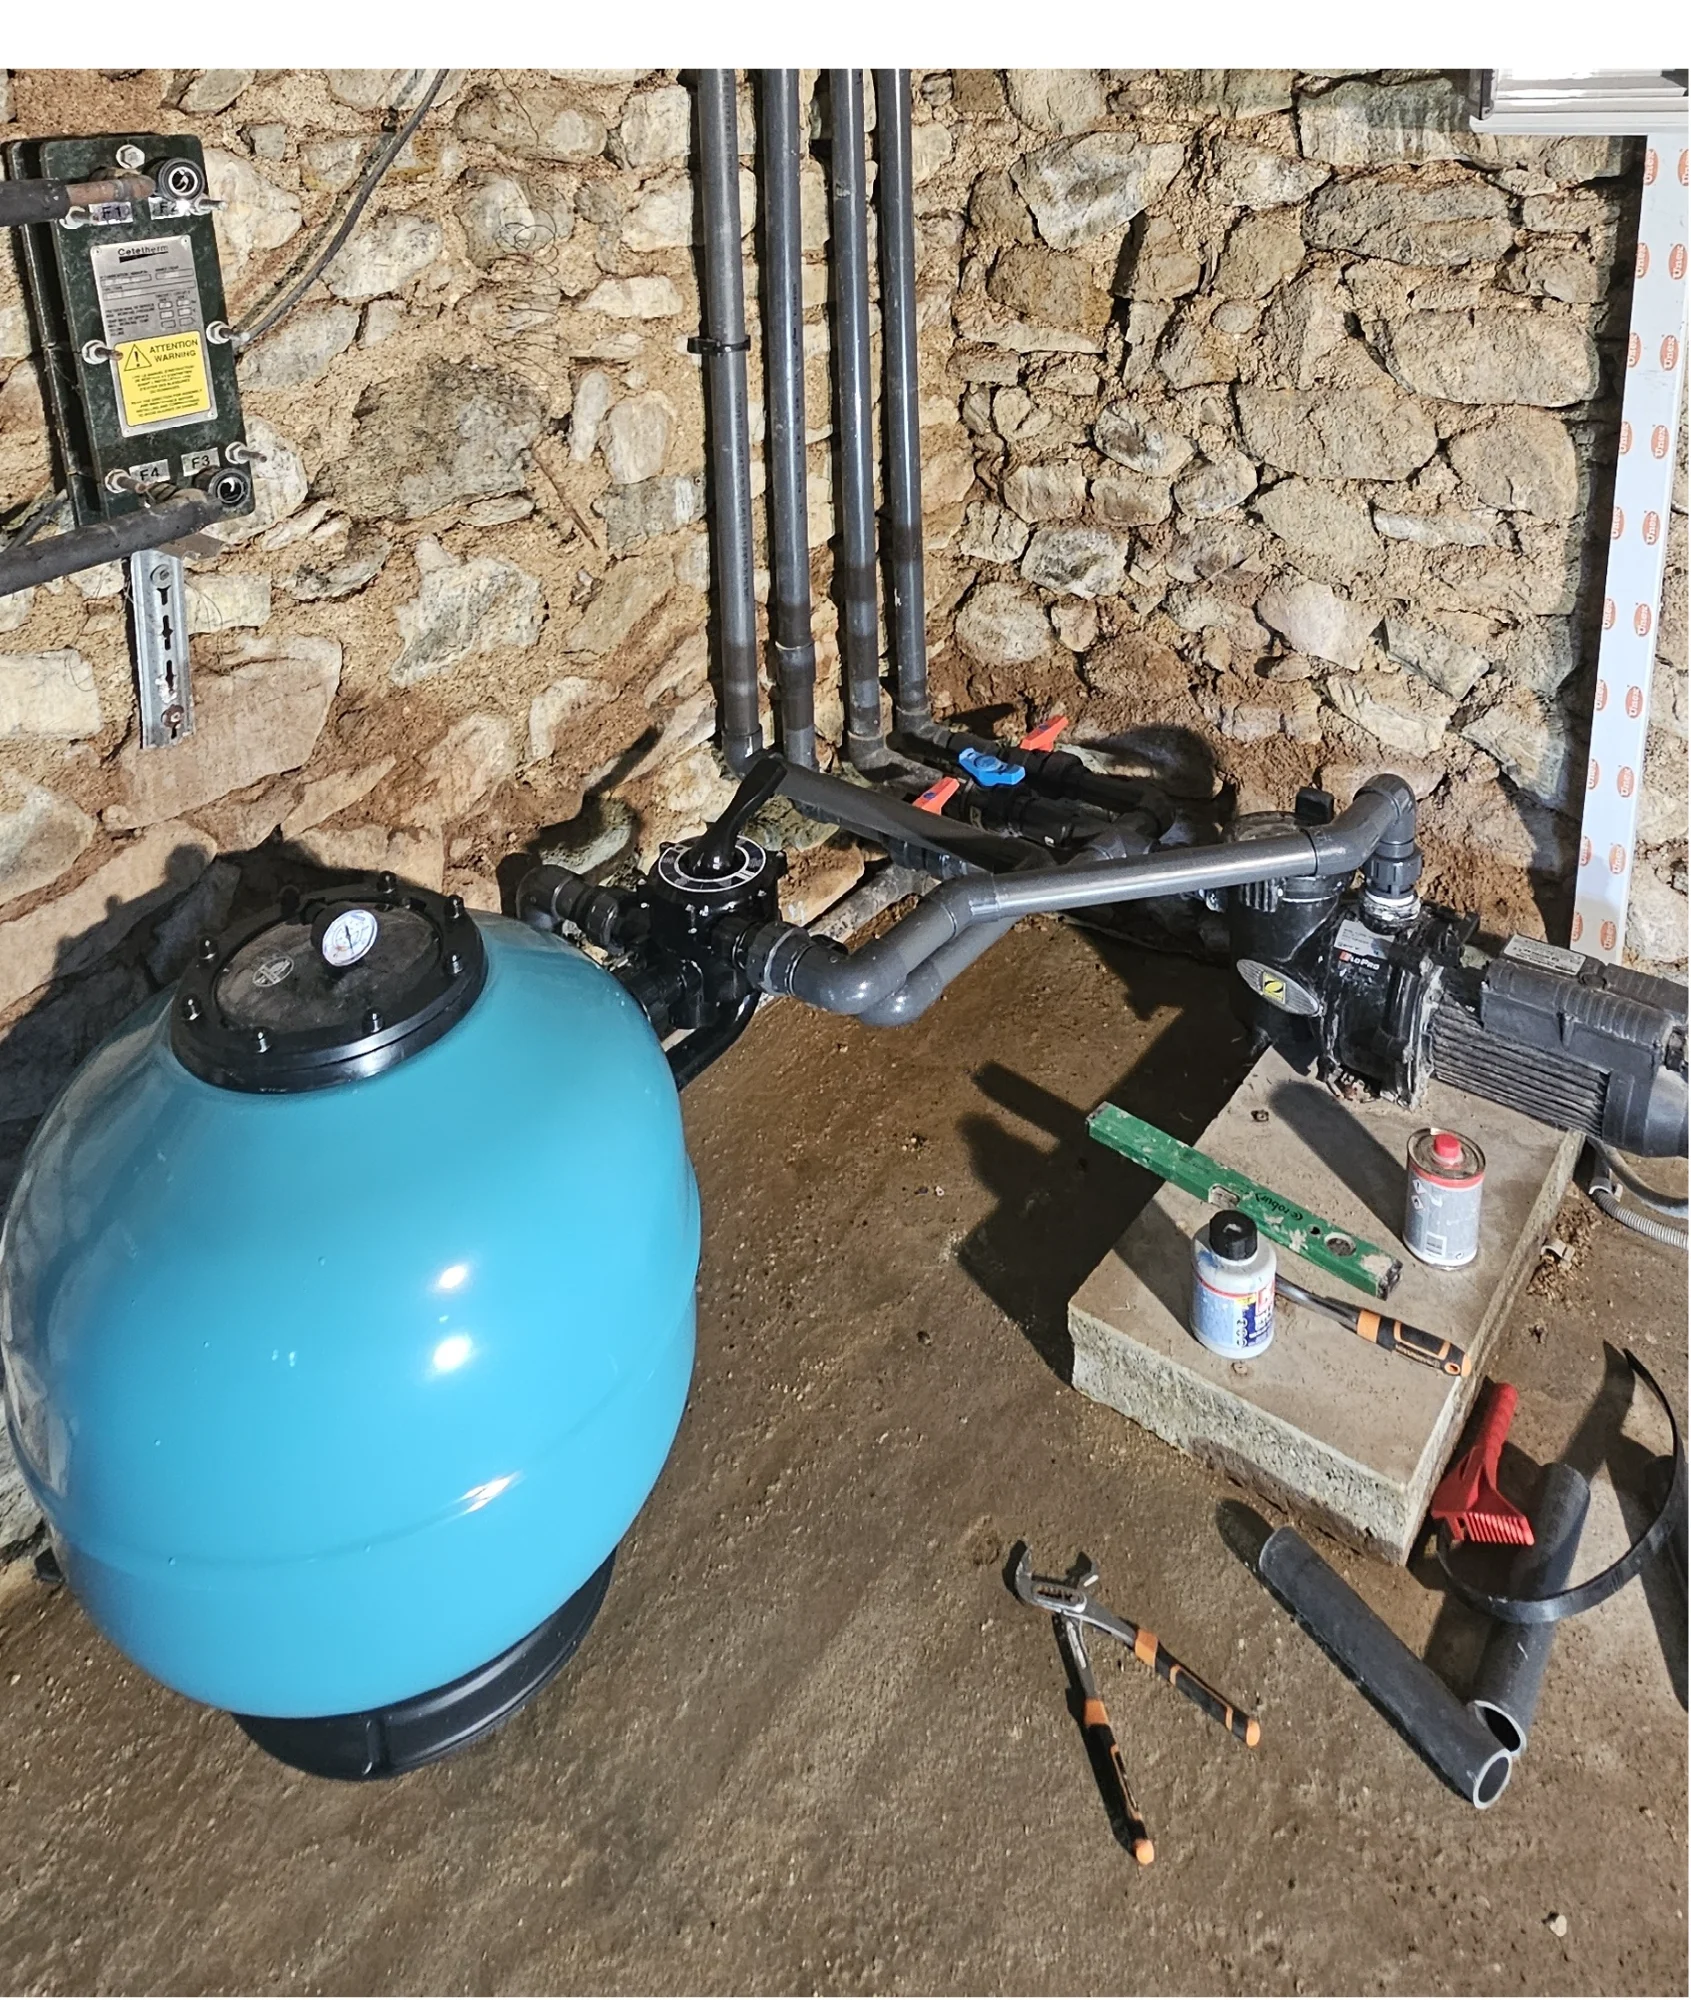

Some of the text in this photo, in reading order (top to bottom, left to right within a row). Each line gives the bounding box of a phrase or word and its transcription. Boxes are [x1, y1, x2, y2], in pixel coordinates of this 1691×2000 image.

[1643, 150, 1655, 183] Unex
[102, 206, 121, 219] F1
[117, 245, 169, 256] Cetetherm
[1672, 245, 1684, 279] Unex
[149, 339, 199, 354] ATTENTION
[154, 349, 197, 363] WARNING
[1627, 334, 1638, 366] Unex
[1663, 336, 1675, 369] Unex
[1619, 422, 1629, 453] Unex
[1654, 426, 1666, 457] Unex
[140, 467, 160, 481] F4
[191, 455, 210, 469] F3
[1611, 507, 1621, 538] Unex
[1646, 513, 1658, 543] Unex
[1603, 600, 1613, 629] Unex
[1637, 605, 1648, 635] Unex
[1629, 686, 1640, 717] Unex
[1620, 768, 1632, 798] Unex
[1612, 845, 1624, 874] Unex
[1603, 921, 1614, 949] Unex
